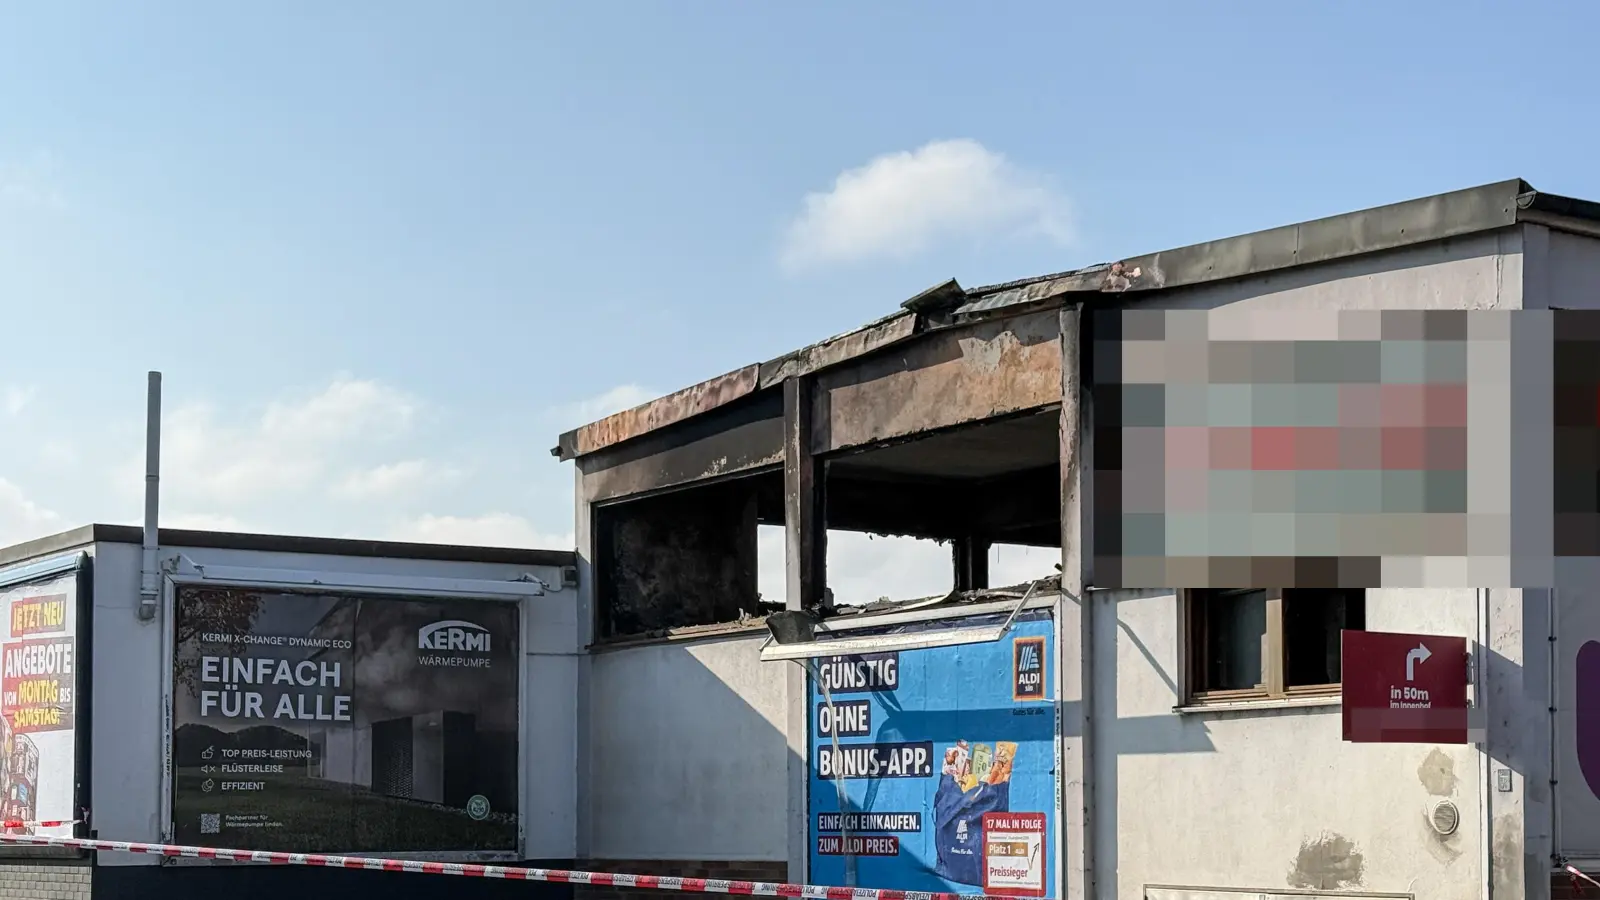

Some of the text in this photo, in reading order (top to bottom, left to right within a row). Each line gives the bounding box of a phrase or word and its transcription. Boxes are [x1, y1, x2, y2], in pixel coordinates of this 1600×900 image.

[12, 601, 65, 632] JETZT NEU
[203, 632, 232, 643] KERMI
[289, 637, 331, 648] DYNAMIC
[332, 640, 351, 649] ECO
[418, 620, 491, 652] KERMI
[4, 643, 72, 679] ANGEBOTE
[418, 654, 491, 668] WÄRMEPUMPE
[202, 656, 341, 688] EINFACH
[820, 656, 896, 688] GÜNSTIG
[1019, 673, 1040, 684] ALDI
[4, 679, 71, 706] VON MONTAG BIS
[1390, 685, 1429, 701] in 50m
[201, 684, 351, 721] FÜR ALLE
[1390, 700, 1432, 709] im Innenhof
[819, 705, 868, 733] OHNE
[221, 749, 312, 759] TOP PREIS-LEISTUNG
[819, 747, 931, 776] BONUS-APP.
[221, 763, 283, 773] FLÜSTERLEISE
[221, 781, 266, 791] EFFIZIENT
[819, 814, 920, 830] EINFACH EINKAUFEN.
[986, 819, 1042, 829] 17 MAL IN FOLGE
[818, 838, 898, 854] ZUM ALDI PREIS.
[989, 844, 1006, 855] Platz
[1007, 845, 1011, 854] 1
[990, 866, 1028, 879] Preissieger
